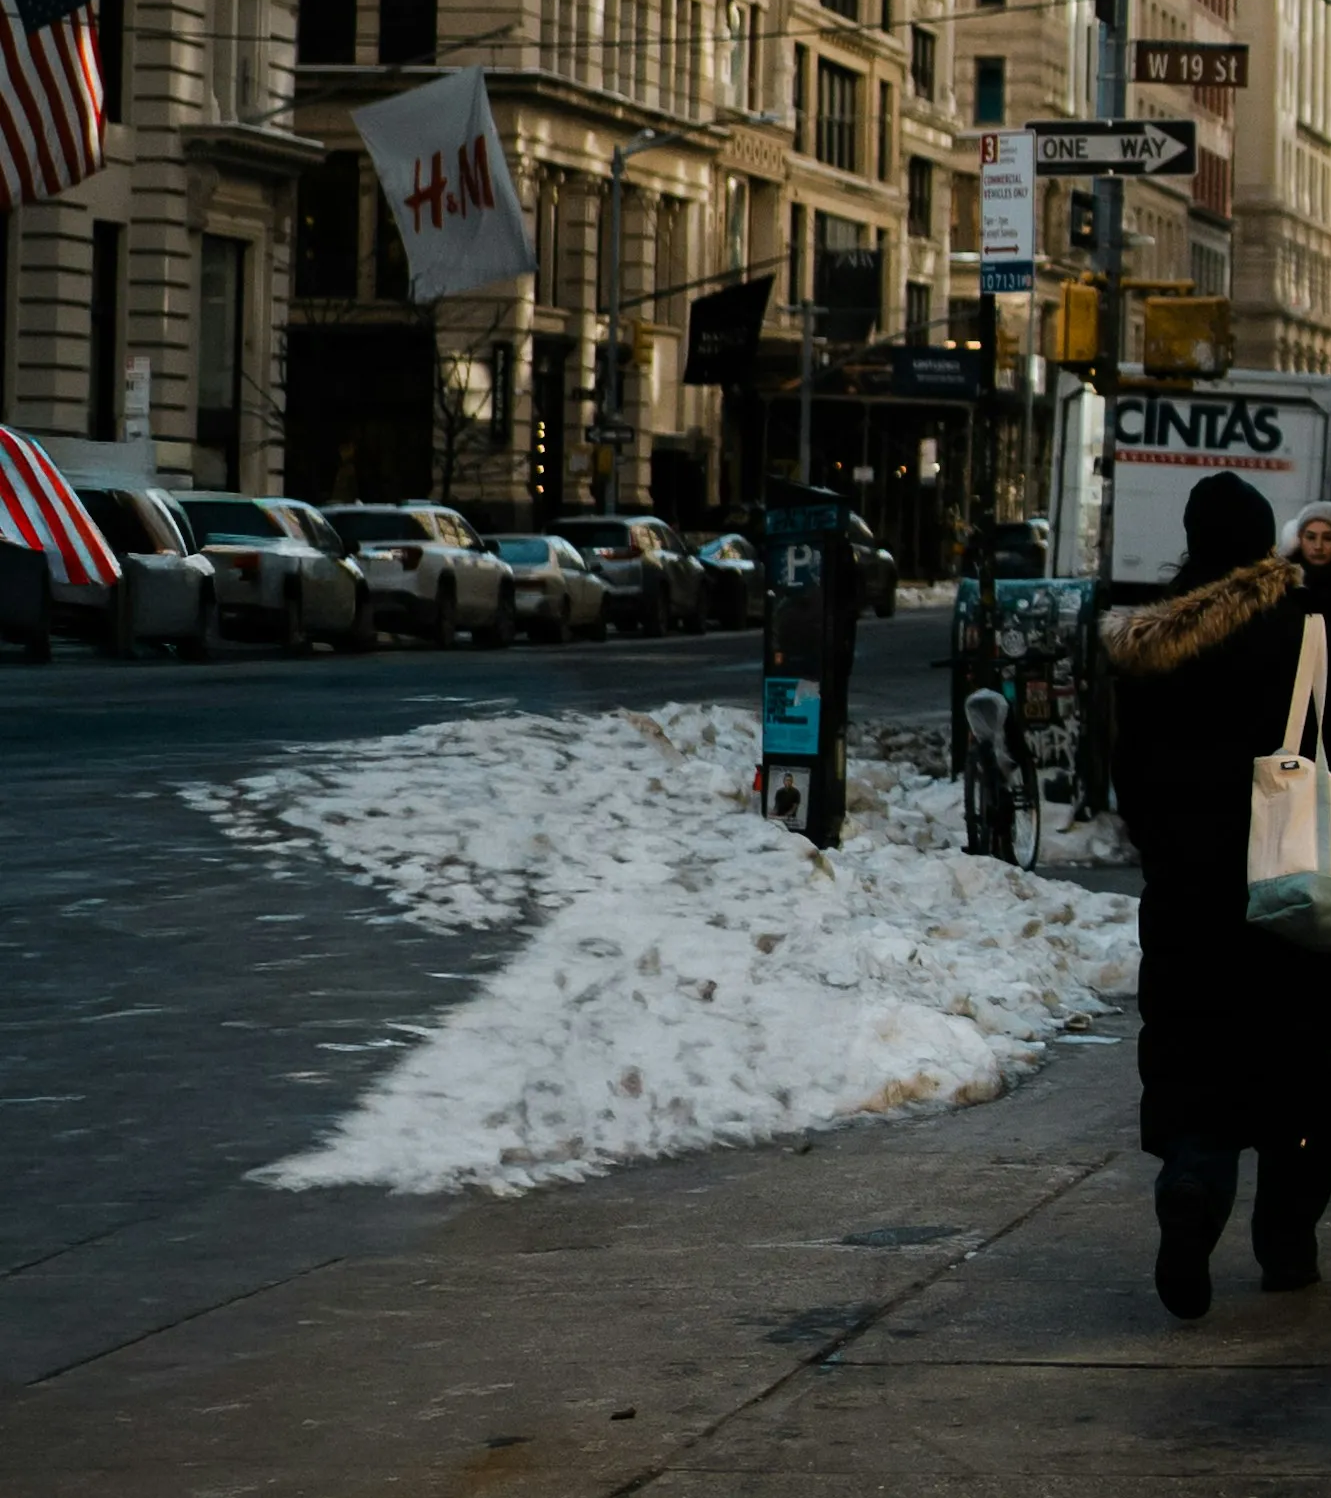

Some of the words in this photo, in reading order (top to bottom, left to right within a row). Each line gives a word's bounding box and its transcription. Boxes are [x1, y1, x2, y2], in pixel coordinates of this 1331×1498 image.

[1148, 52, 1168, 79] W
[1180, 53, 1204, 81] 19
[1214, 55, 1238, 83] St
[985, 136, 995, 163] 3
[1042, 137, 1088, 160] ONE
[1119, 137, 1167, 159] WAY
[403, 134, 495, 234] H&M
[1115, 397, 1282, 453] CINTAS
